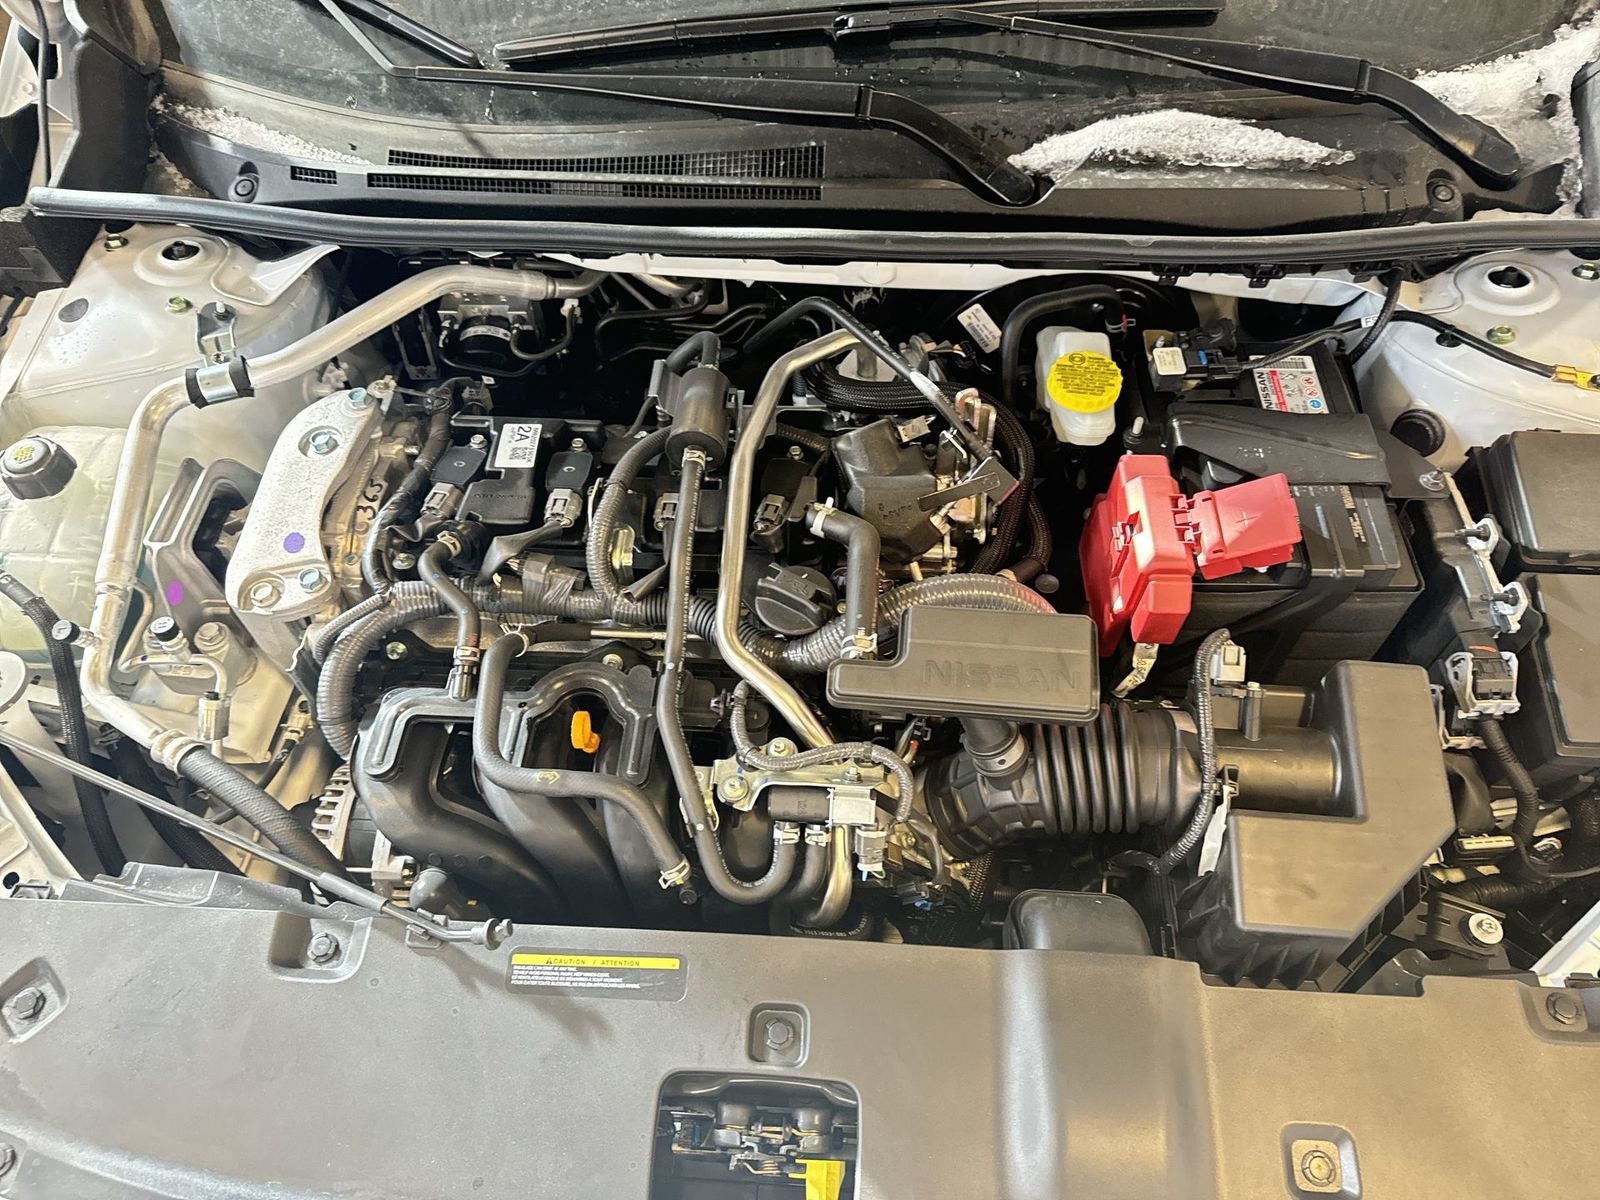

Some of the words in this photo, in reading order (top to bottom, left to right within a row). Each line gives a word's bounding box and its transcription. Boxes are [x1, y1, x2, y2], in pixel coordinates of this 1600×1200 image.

[1256, 372, 1274, 409] NISSAN
[515, 426, 532, 442] 2A
[922, 658, 1078, 692] NISSAN
[600, 959, 640, 967] ATTENTION
